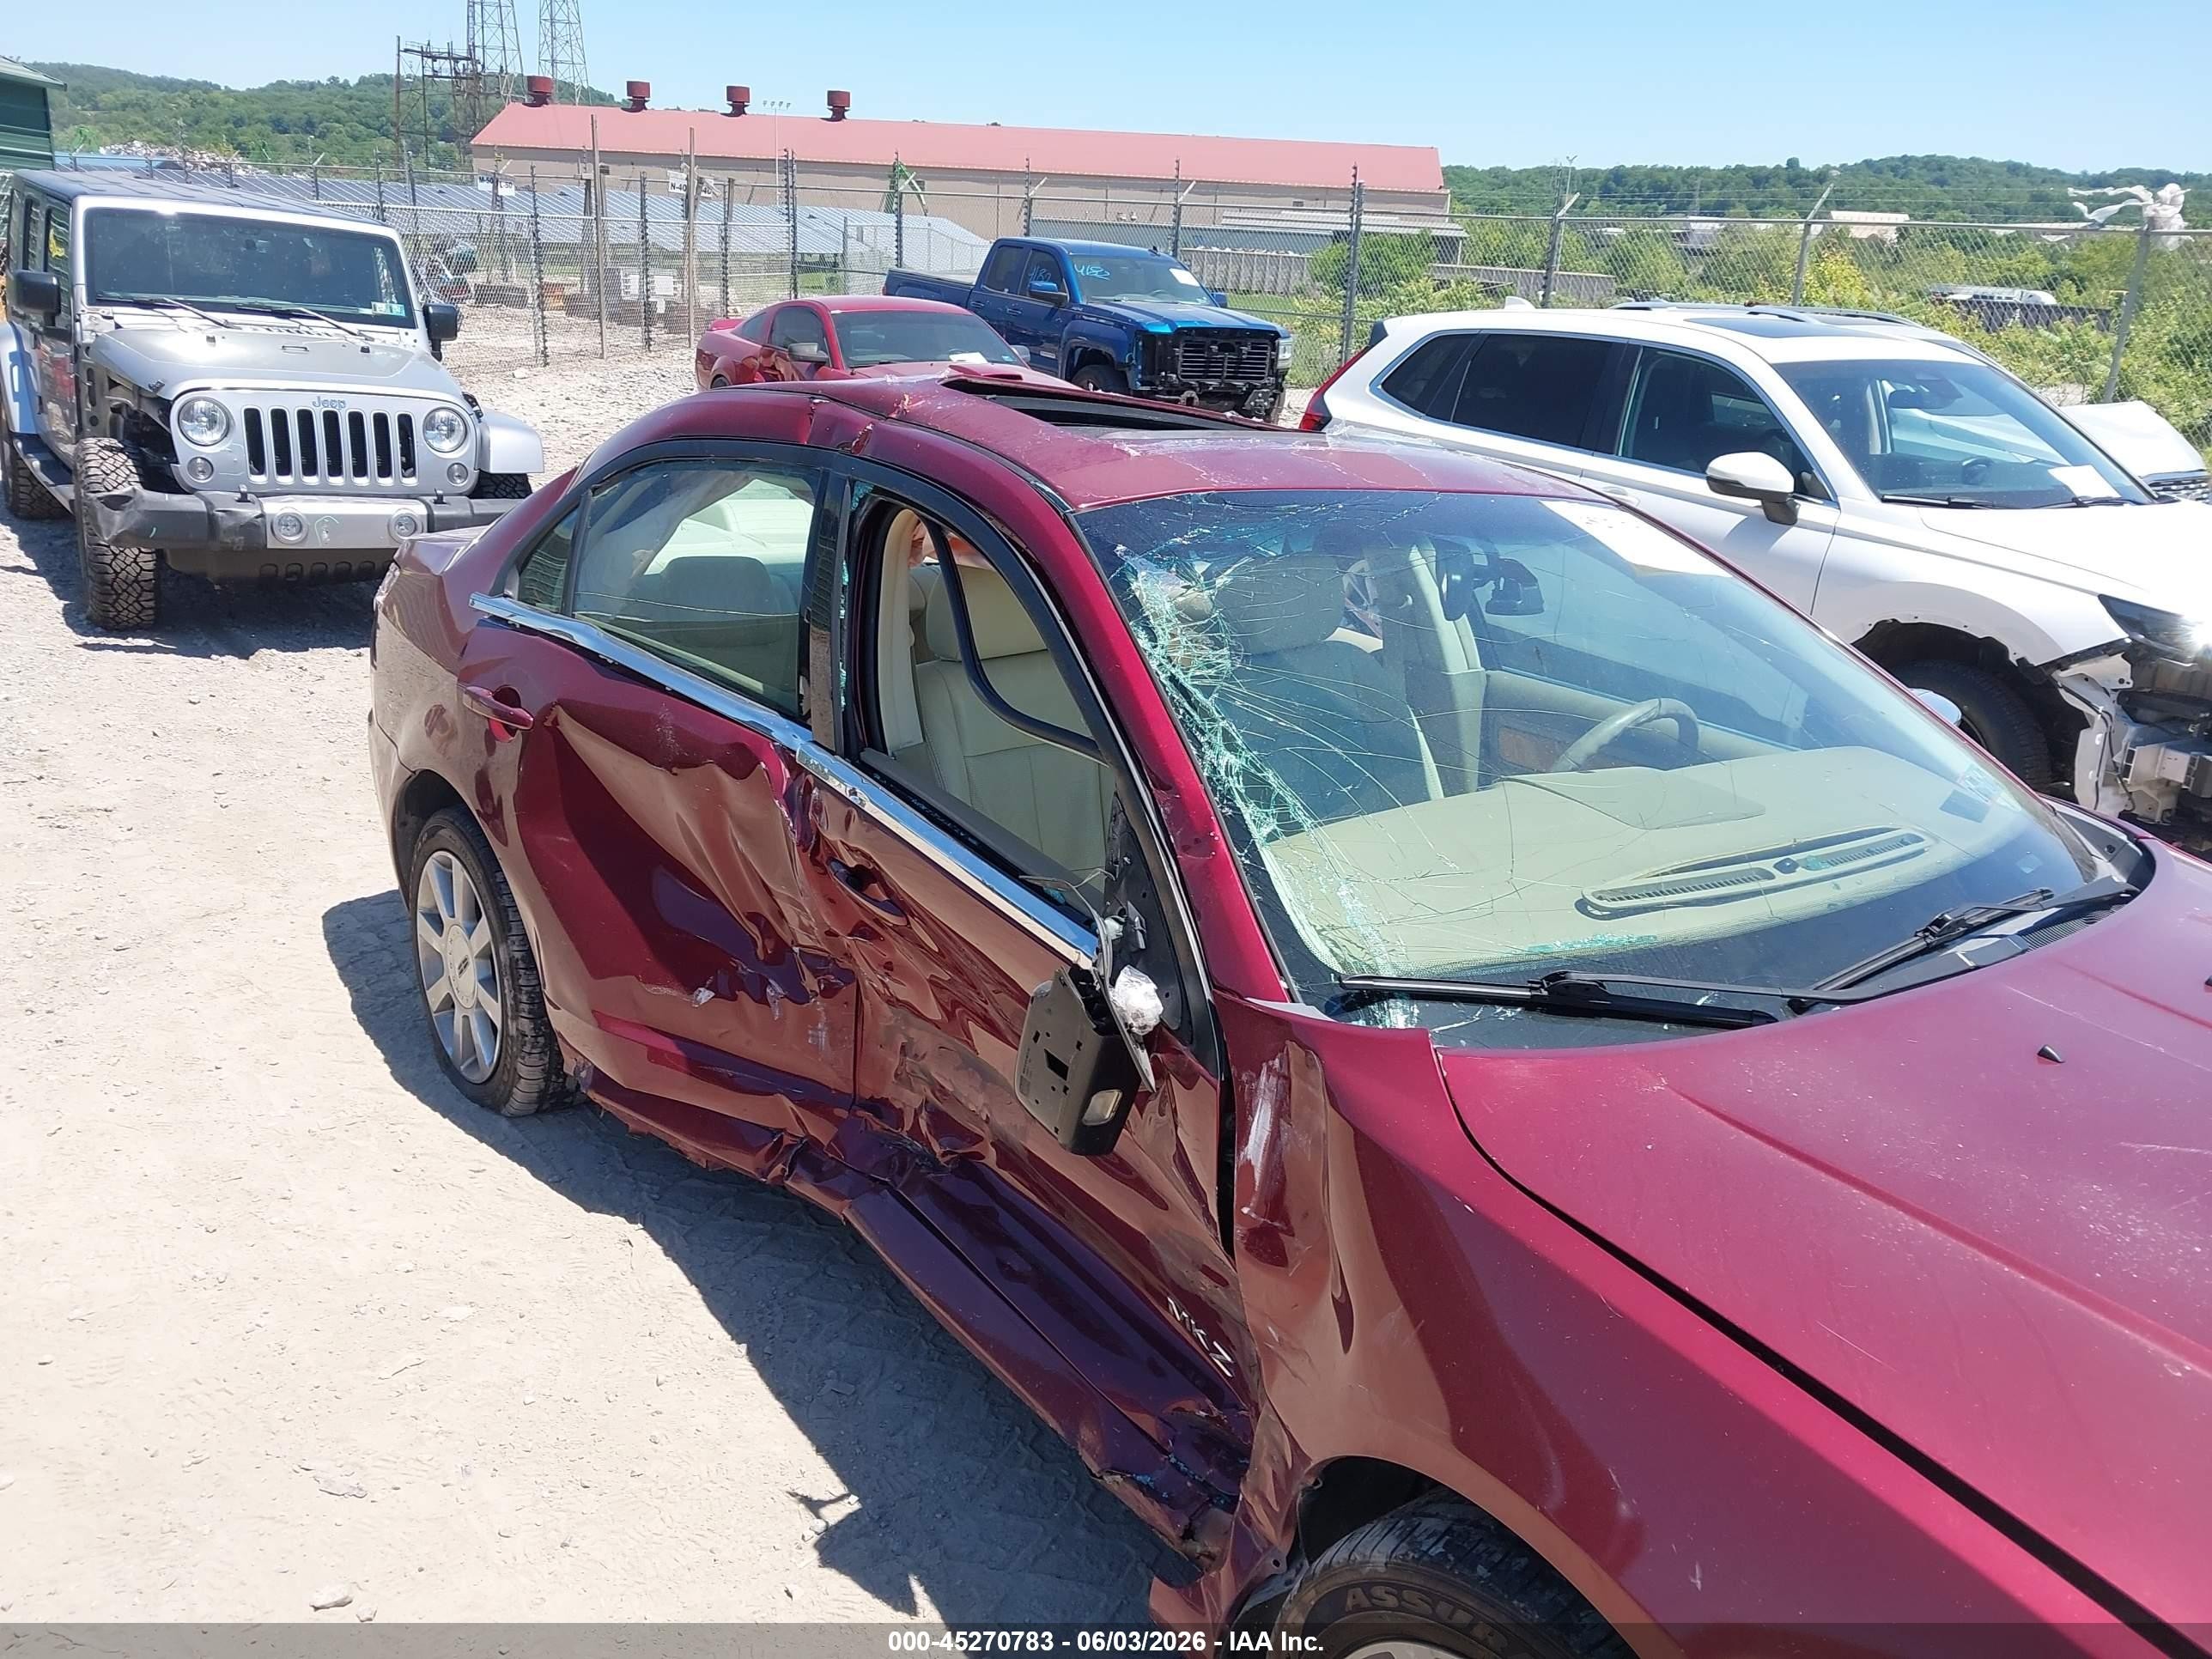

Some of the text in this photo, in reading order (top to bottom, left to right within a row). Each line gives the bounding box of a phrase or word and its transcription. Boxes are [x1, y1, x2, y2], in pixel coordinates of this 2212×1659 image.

[670, 181, 687, 192] N-40
[312, 395, 346, 410] Jeep
[1167, 1296, 1237, 1378] MKZ
[1345, 1585, 1535, 1659] ASSUR
